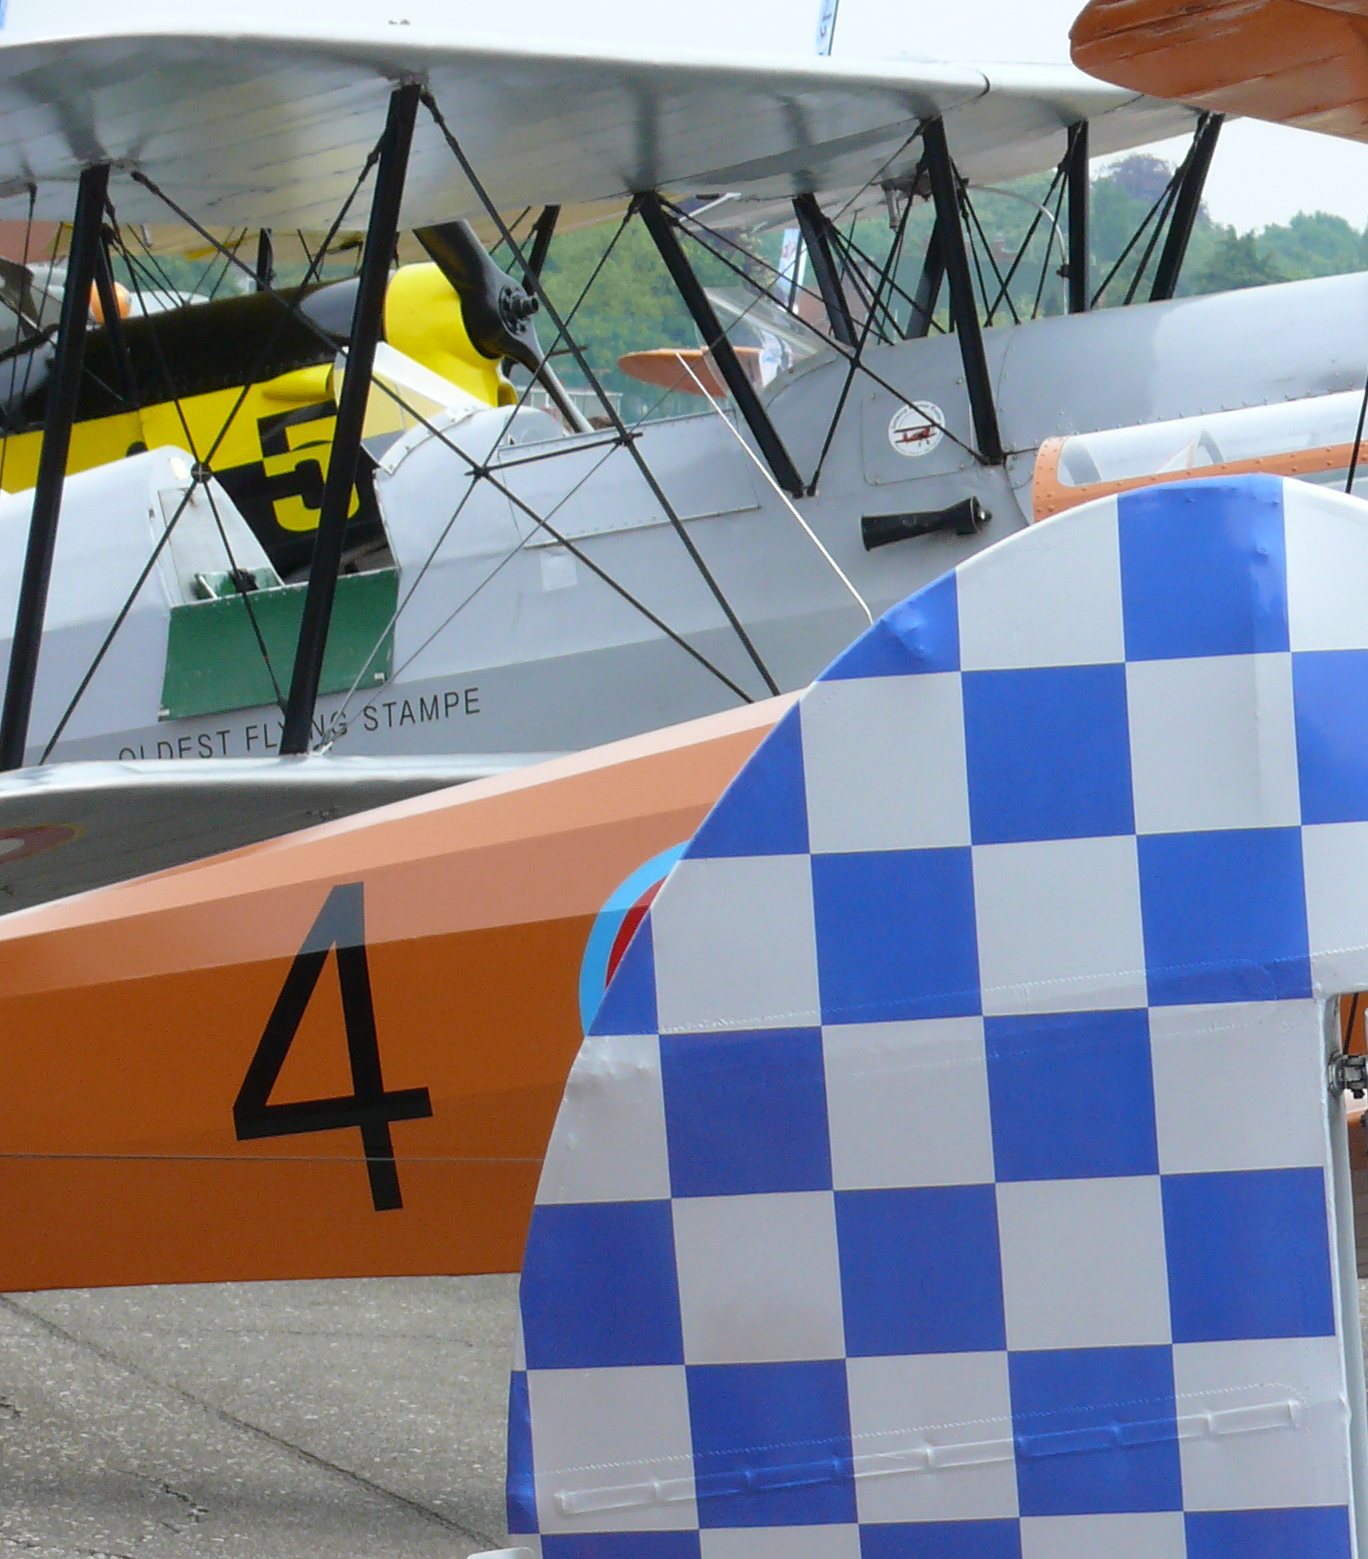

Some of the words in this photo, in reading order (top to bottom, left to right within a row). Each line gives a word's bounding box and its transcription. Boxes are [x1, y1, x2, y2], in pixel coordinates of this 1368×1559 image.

[257, 400, 360, 532] 5
[119, 730, 230, 760] OLDEST
[246, 711, 348, 752] FLNG
[363, 687, 481, 731] STAMPE
[233, 882, 433, 1211] 4
